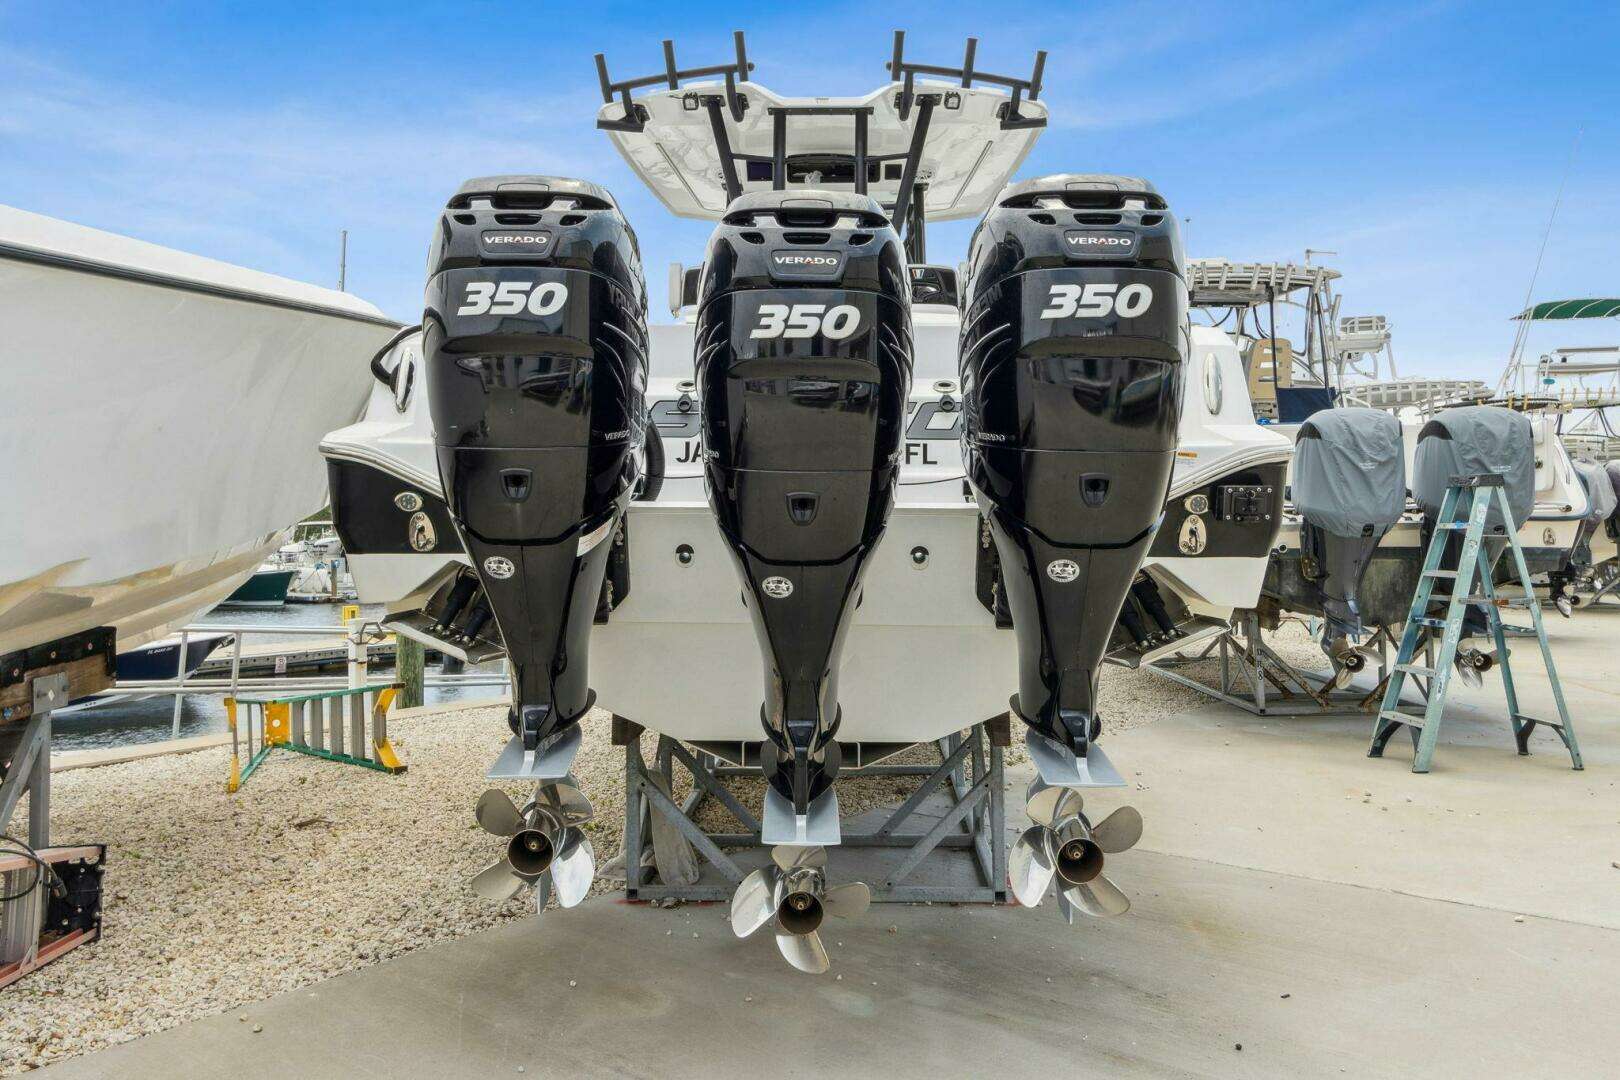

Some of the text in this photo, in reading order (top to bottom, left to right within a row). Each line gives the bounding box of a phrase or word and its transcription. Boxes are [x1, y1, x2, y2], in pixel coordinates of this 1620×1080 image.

[484, 236, 547, 244] VERADO
[1067, 237, 1132, 246] VERADO
[774, 256, 838, 266] VERADO
[457, 281, 568, 316] 350
[1040, 283, 1153, 319] 350
[749, 304, 861, 340] 350
[905, 443, 938, 465] FL
